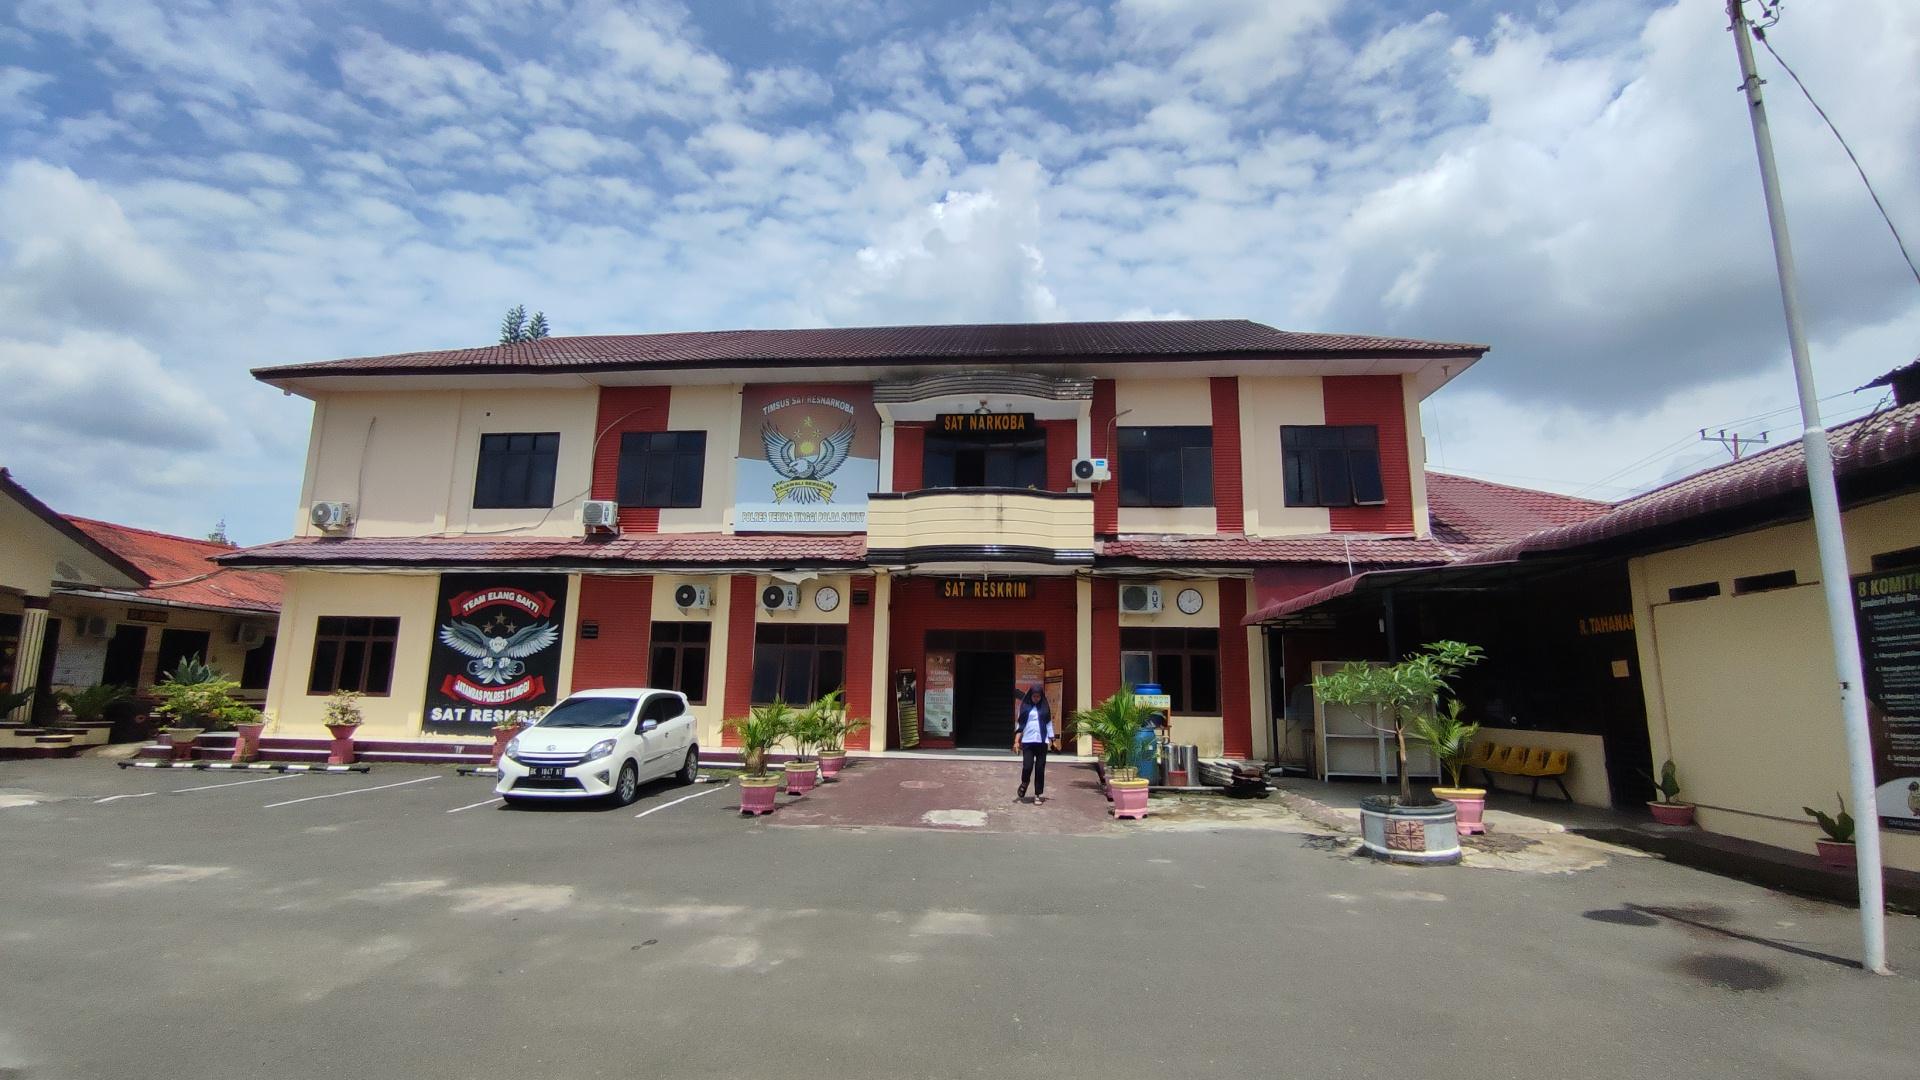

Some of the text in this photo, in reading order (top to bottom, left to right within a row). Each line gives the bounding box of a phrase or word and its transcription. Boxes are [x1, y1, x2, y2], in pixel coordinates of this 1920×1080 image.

[762, 396, 855, 416] TIMSUS SAT RESNARKOBA
[944, 415, 1025, 431] SAT NARKOBA
[742, 511, 767, 523] POLRES
[944, 581, 1026, 598] SAT RESKRIM
[1857, 581, 1867, 597] 8
[463, 591, 540, 613] TEAM ELANG SAKTI
[1151, 590, 1159, 609] AUX
[483, 689, 505, 703] POLRES
[431, 707, 544, 724] SAT RESKRI
